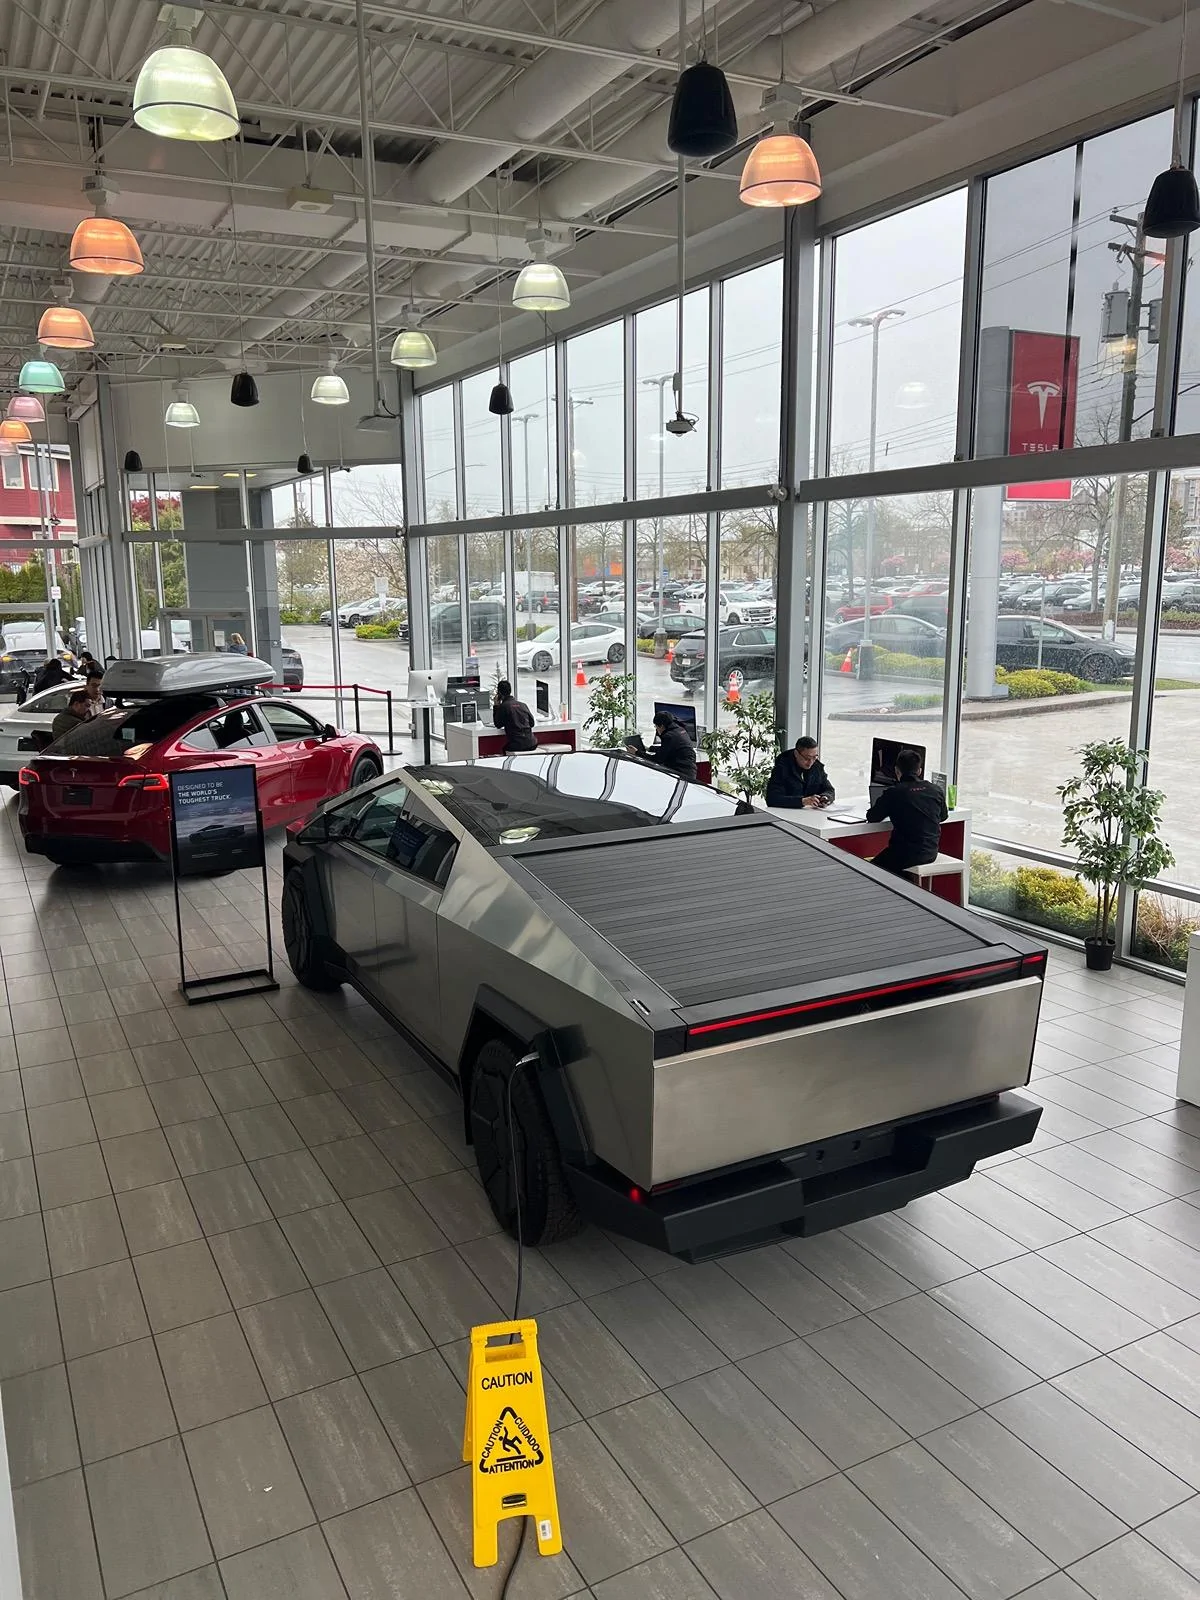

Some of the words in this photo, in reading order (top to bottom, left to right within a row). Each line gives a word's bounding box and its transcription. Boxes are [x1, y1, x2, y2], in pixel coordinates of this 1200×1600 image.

[1022, 443, 1059, 452] TESLA
[481, 1371, 533, 1390] CAUTION
[481, 1420, 503, 1459] CAUTION
[514, 1417, 540, 1452] CUIDADO
[488, 1459, 535, 1474] ATTENTION
